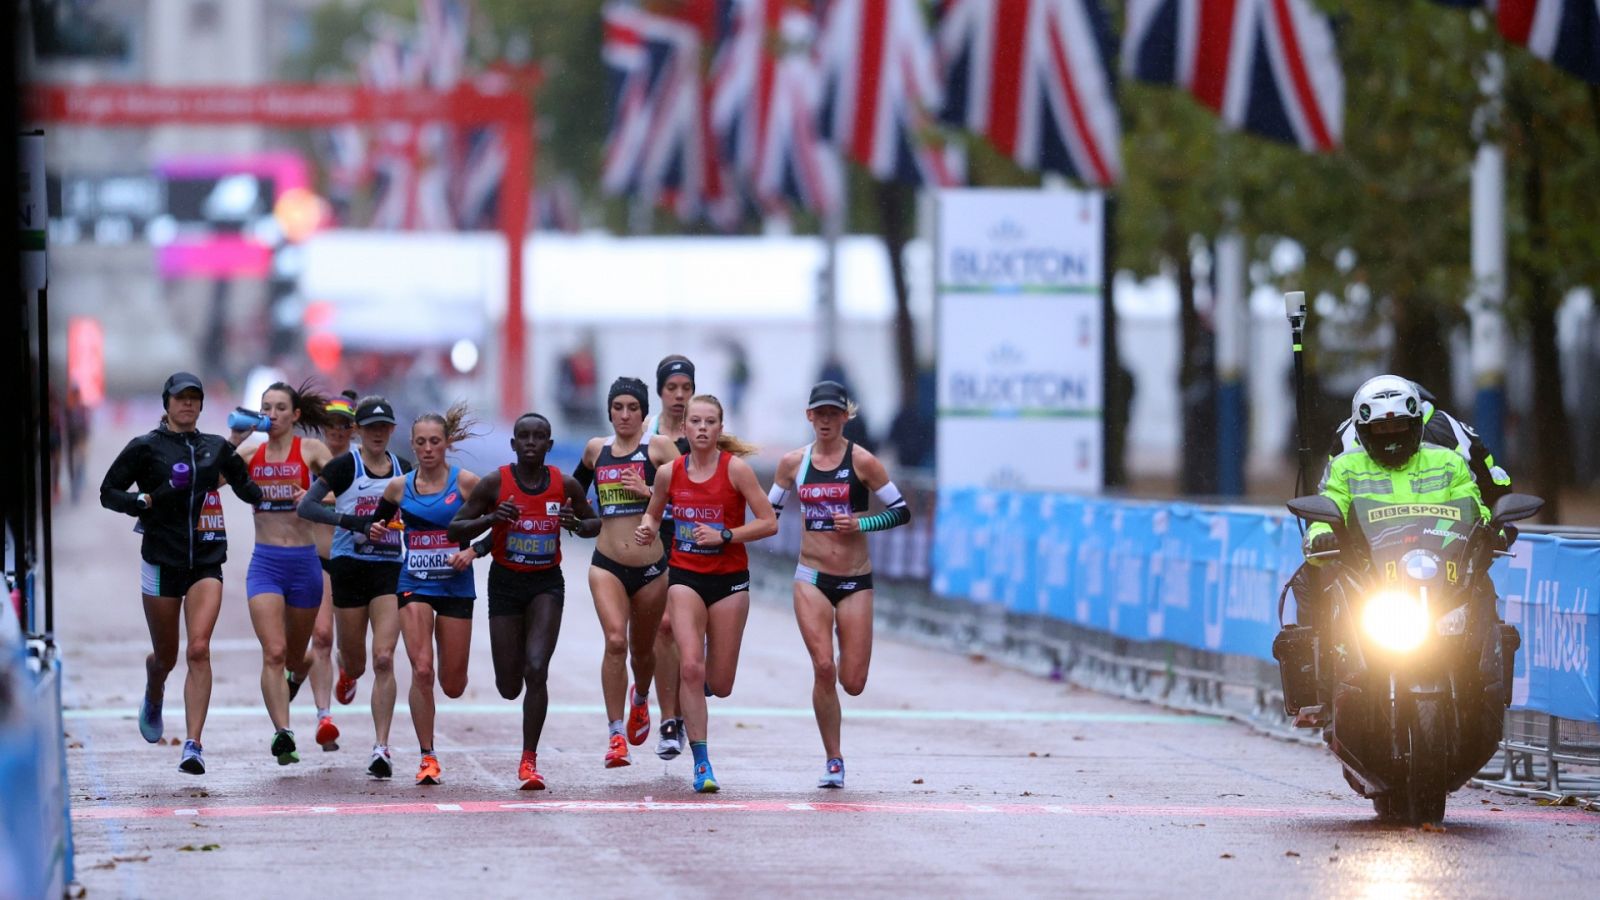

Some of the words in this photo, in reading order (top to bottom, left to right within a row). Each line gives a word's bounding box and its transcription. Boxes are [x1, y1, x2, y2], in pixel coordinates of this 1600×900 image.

[253, 464, 301, 478] MONEY
[800, 487, 846, 498] MONEY
[673, 505, 721, 519] MONEY
[1371, 506, 1410, 521] BBC
[1412, 506, 1458, 518] SPORT
[410, 534, 448, 546] MONE
[507, 536, 539, 553] PACE
[544, 538, 556, 552] 10
[409, 553, 449, 568] COCKRA
[1448, 563, 1456, 581] 2
